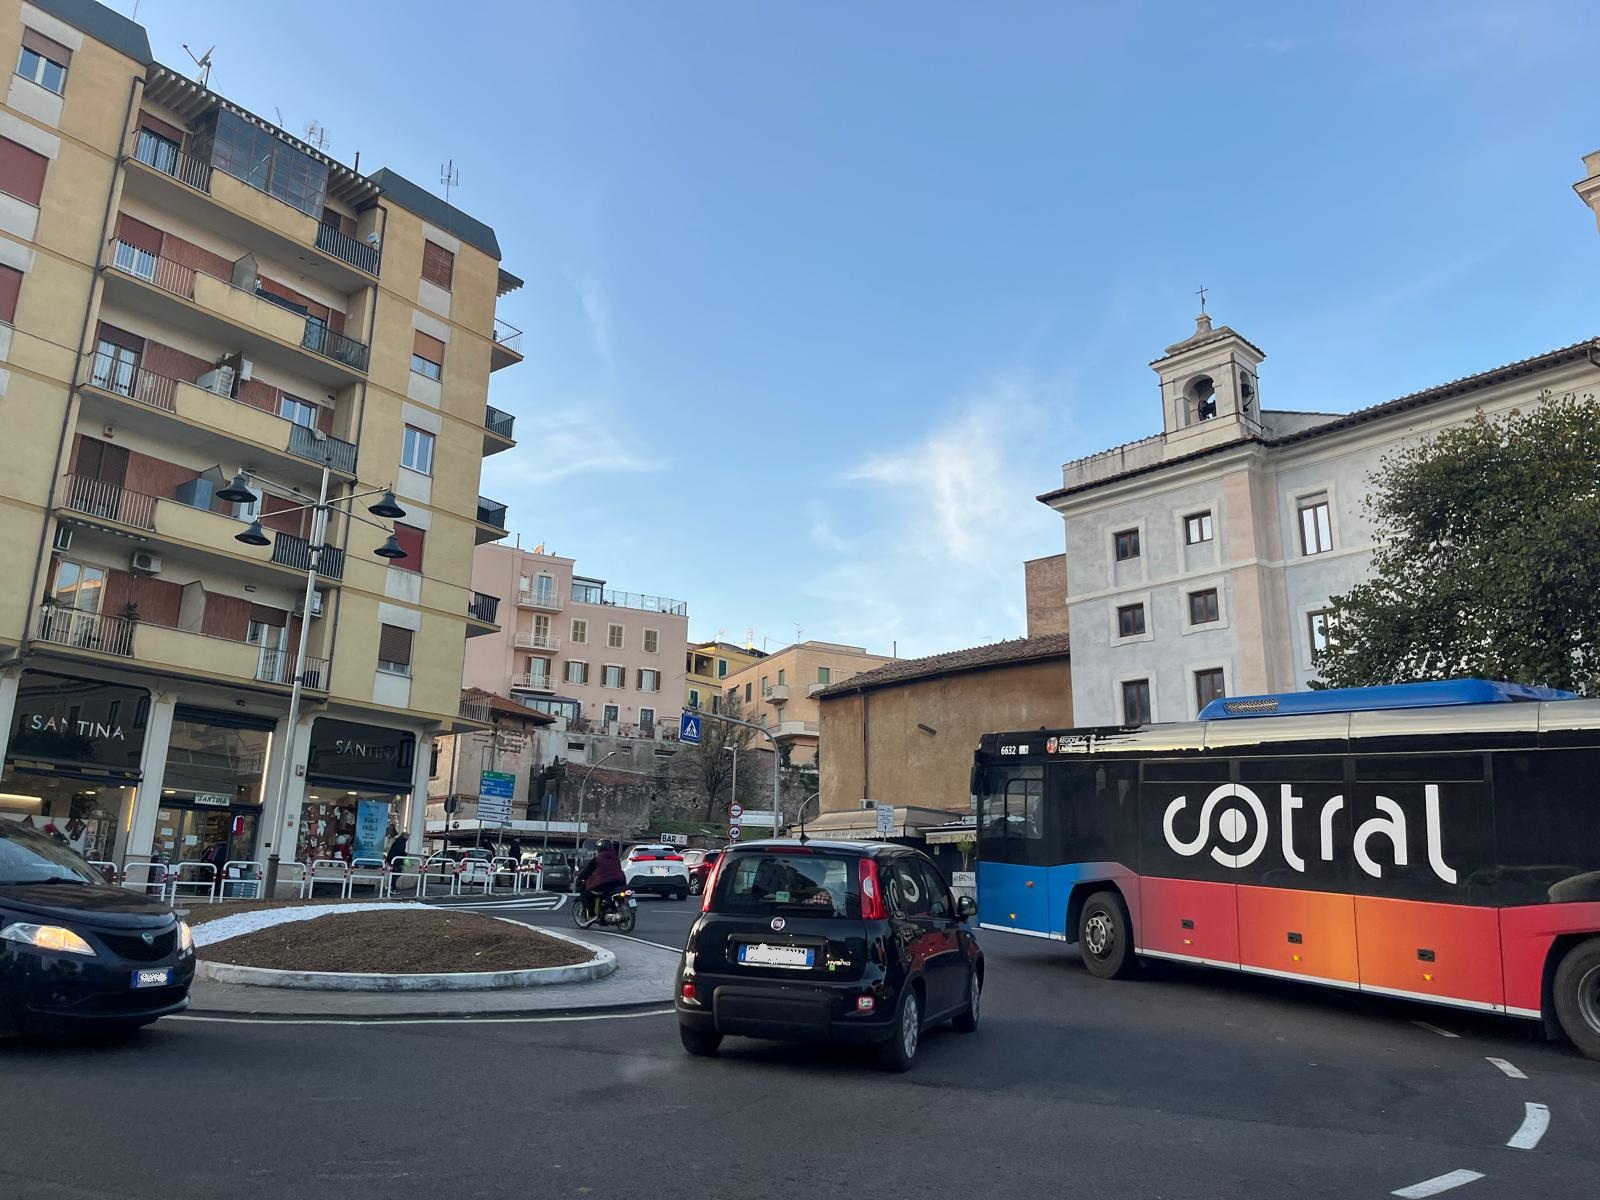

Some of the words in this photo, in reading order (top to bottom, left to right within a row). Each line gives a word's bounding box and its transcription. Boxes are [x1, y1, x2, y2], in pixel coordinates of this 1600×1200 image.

[31, 714, 125, 741] SANTINA
[1000, 745, 1017, 756] 6632
[661, 834, 676, 843] BAR
[1162, 783, 1457, 885] cotral
